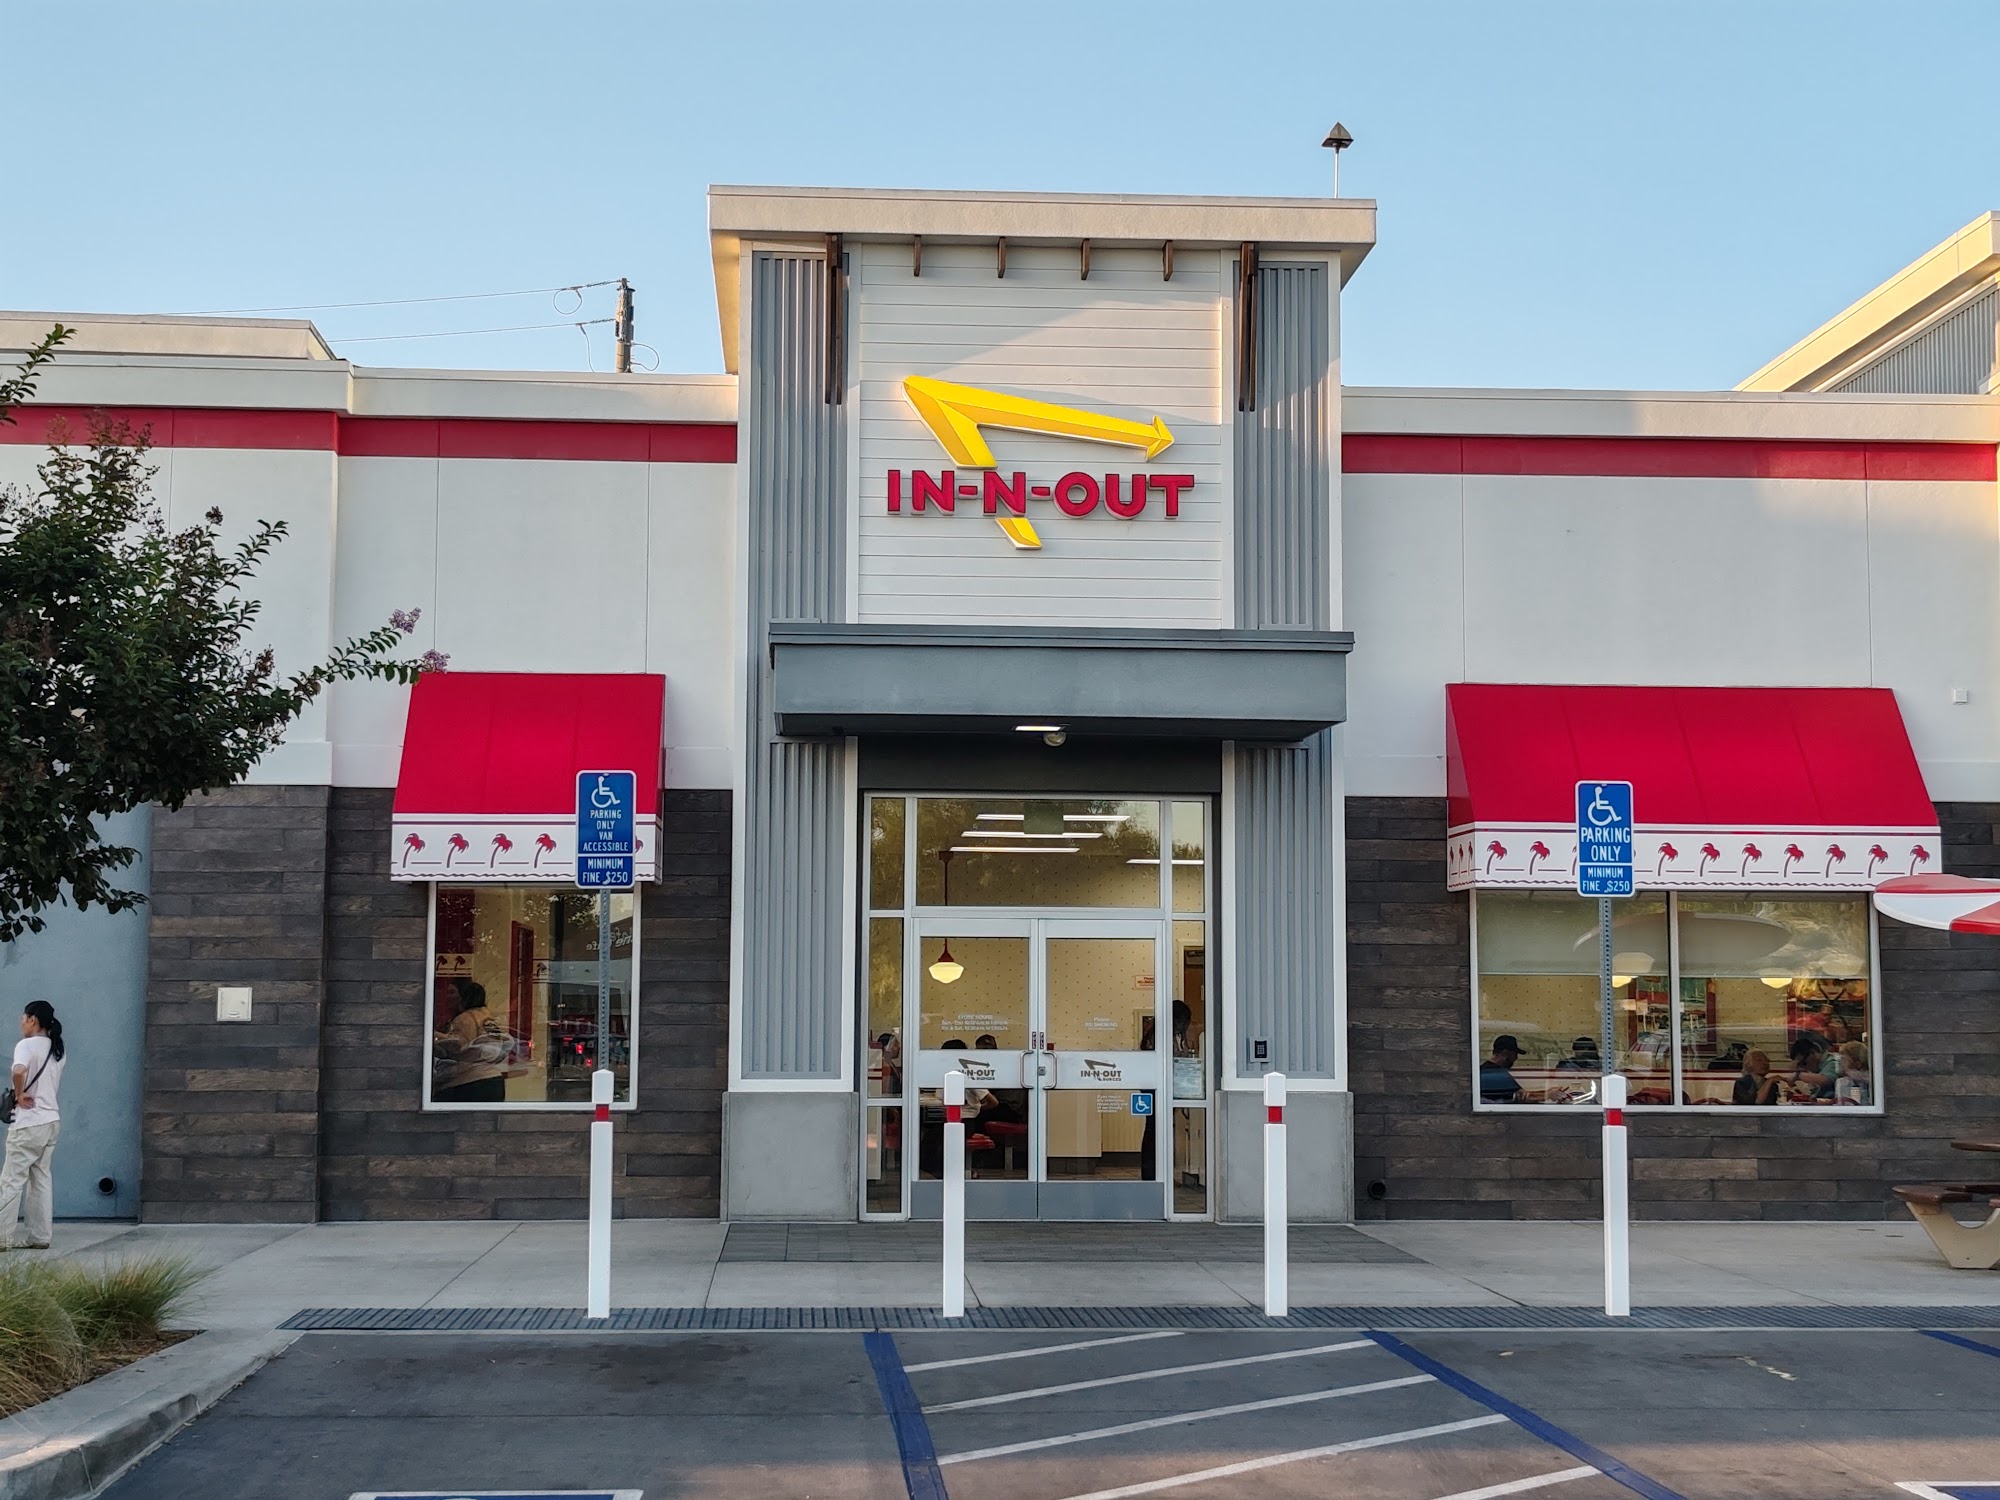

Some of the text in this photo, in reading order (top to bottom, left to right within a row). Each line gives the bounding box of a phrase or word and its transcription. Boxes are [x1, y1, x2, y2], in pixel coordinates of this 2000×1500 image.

[887, 469, 1195, 520] IN-N-OUT
[590, 810, 622, 819] PARKING
[596, 820, 615, 830] ONLY
[599, 831, 613, 841] VAN
[1580, 827, 1631, 844] PARKING
[583, 841, 629, 852] ACCESSIBLE
[1591, 845, 1621, 861] ONLY
[587, 858, 624, 870] MINIMUM
[582, 871, 628, 884] FINE $250
[1587, 867, 1624, 878] MINIMUM
[1582, 880, 1630, 892] FINE $250
